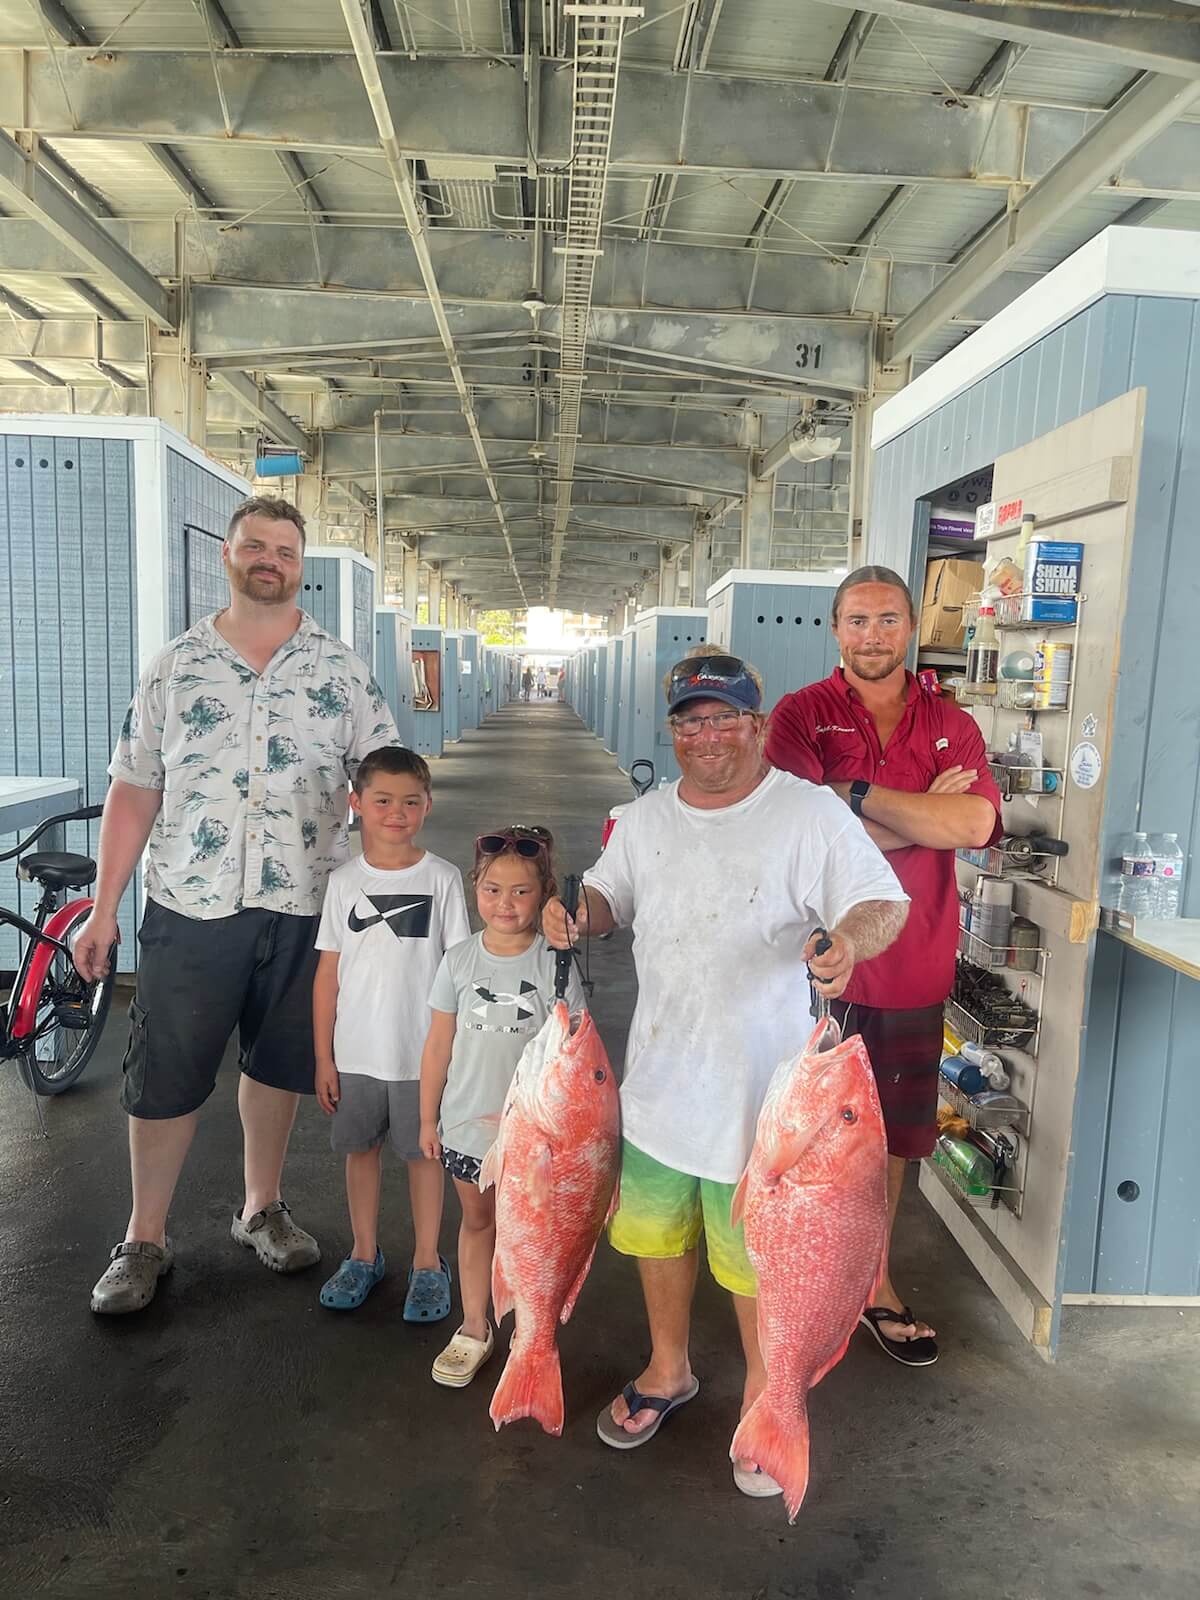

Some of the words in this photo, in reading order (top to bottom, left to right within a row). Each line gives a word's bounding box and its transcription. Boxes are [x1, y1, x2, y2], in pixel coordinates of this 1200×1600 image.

[795, 343, 821, 369] 31
[522, 362, 549, 383] 31
[1036, 564, 1077, 579] SHEILA
[1035, 578, 1077, 593] SHINE
